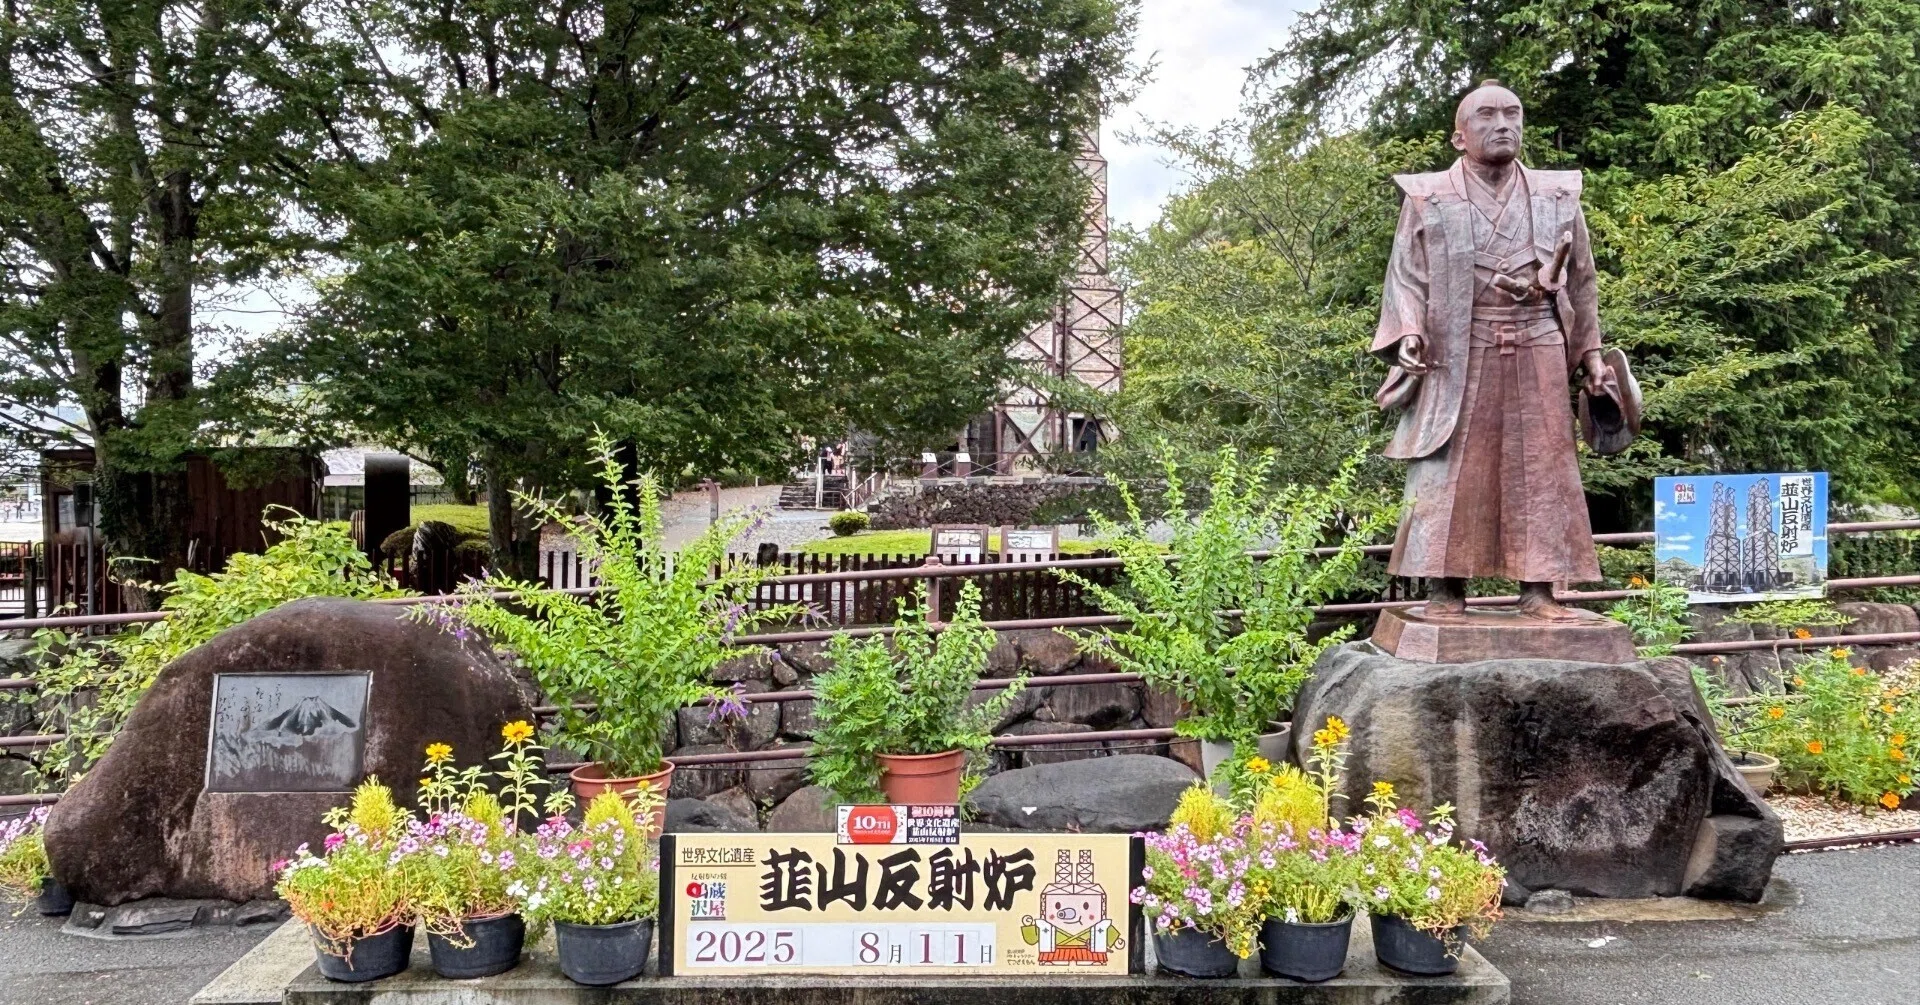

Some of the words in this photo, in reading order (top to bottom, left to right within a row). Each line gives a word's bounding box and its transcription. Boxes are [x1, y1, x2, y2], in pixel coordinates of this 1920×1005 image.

[1780, 482, 1799, 554] 韮山反射炉
[682, 847, 755, 864] 世界文化遺産
[759, 847, 1037, 911] 韮山反射炉
[695, 930, 795, 963] 2025
